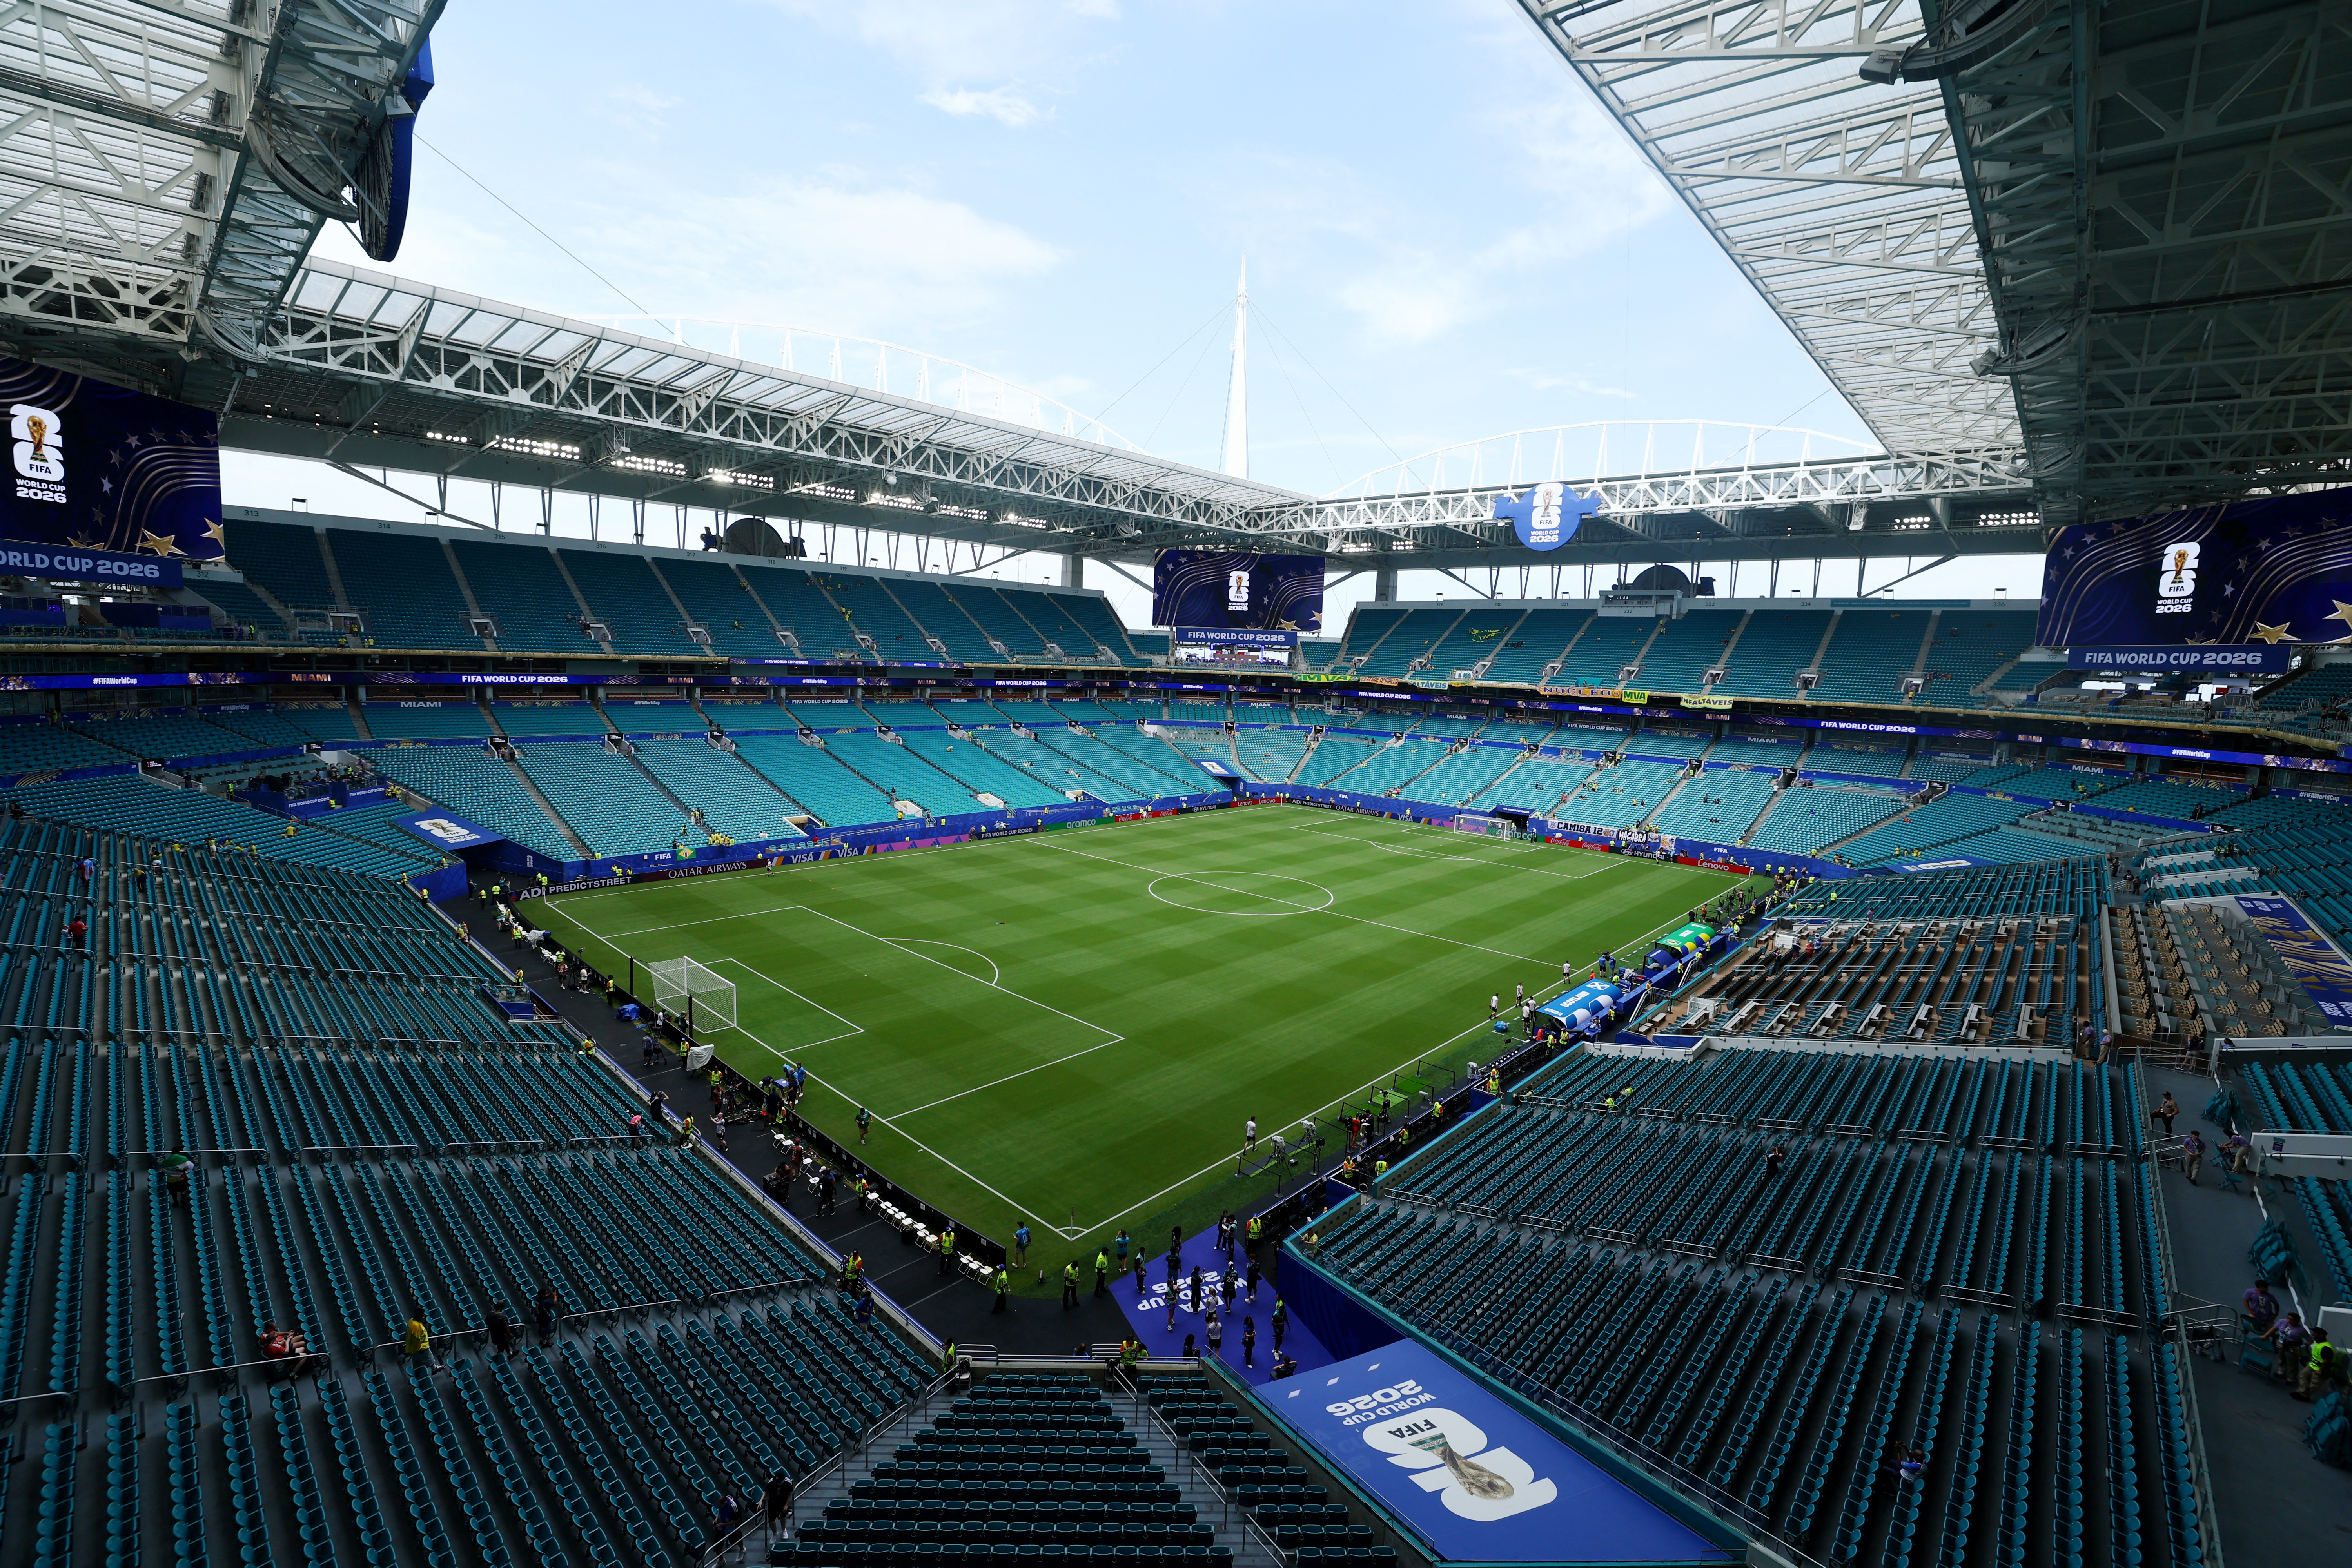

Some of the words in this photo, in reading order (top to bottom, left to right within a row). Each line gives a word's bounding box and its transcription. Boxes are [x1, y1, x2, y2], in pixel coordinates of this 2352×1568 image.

[29, 464, 51, 474] FIFA
[16, 479, 48, 489] WORLD
[16, 487, 67, 503] 2026
[54, 556, 93, 572] CUP
[97, 560, 159, 578] 2026
[2156, 604, 2192, 613] 2026
[2085, 653, 2112, 663] FIFA
[2116, 653, 2167, 664] WORLD
[2170, 653, 2200, 664] CUP
[2203, 653, 2262, 664] 2026
[1544, 687, 1611, 696] NUCLEO
[1624, 691, 1646, 700] MVA
[1681, 696, 1733, 706] INFALTÁVEIS
[2172, 749, 2210, 759] #FIFAWorldCup
[2072, 765, 2103, 775] MIAMI
[2299, 790, 2339, 802] #FIFAWorldCup
[1160, 808, 1172, 817] Coca-Cola
[1356, 808, 1379, 816] AIRWAYS
[1398, 813, 1413, 822] VISA
[1067, 819, 1096, 829] aramco
[1557, 822, 1590, 834] CAMISA
[1593, 827, 1603, 835] 12
[448, 834, 481, 843] 2026
[1550, 837, 1570, 846] Coca-Cola
[1619, 830, 1646, 843] MACABRA
[1582, 842, 1602, 851] Coca-Cola
[791, 852, 814, 864] VISA
[838, 848, 858, 858] VISA
[668, 866, 702, 879] QATAR
[707, 862, 747, 874] AIRWAYS
[1698, 860, 1729, 871] Lenovo
[519, 888, 545, 900] ADI
[549, 876, 632, 894] PREDICTSTREET
[1560, 991, 1590, 1007] SCOTLAND
[1326, 1379, 1423, 1416] 2026
[1376, 1393, 1437, 1416] WORLD
[1343, 1412, 1376, 1426] CUP
[1387, 1419, 1437, 1439] FIFA
